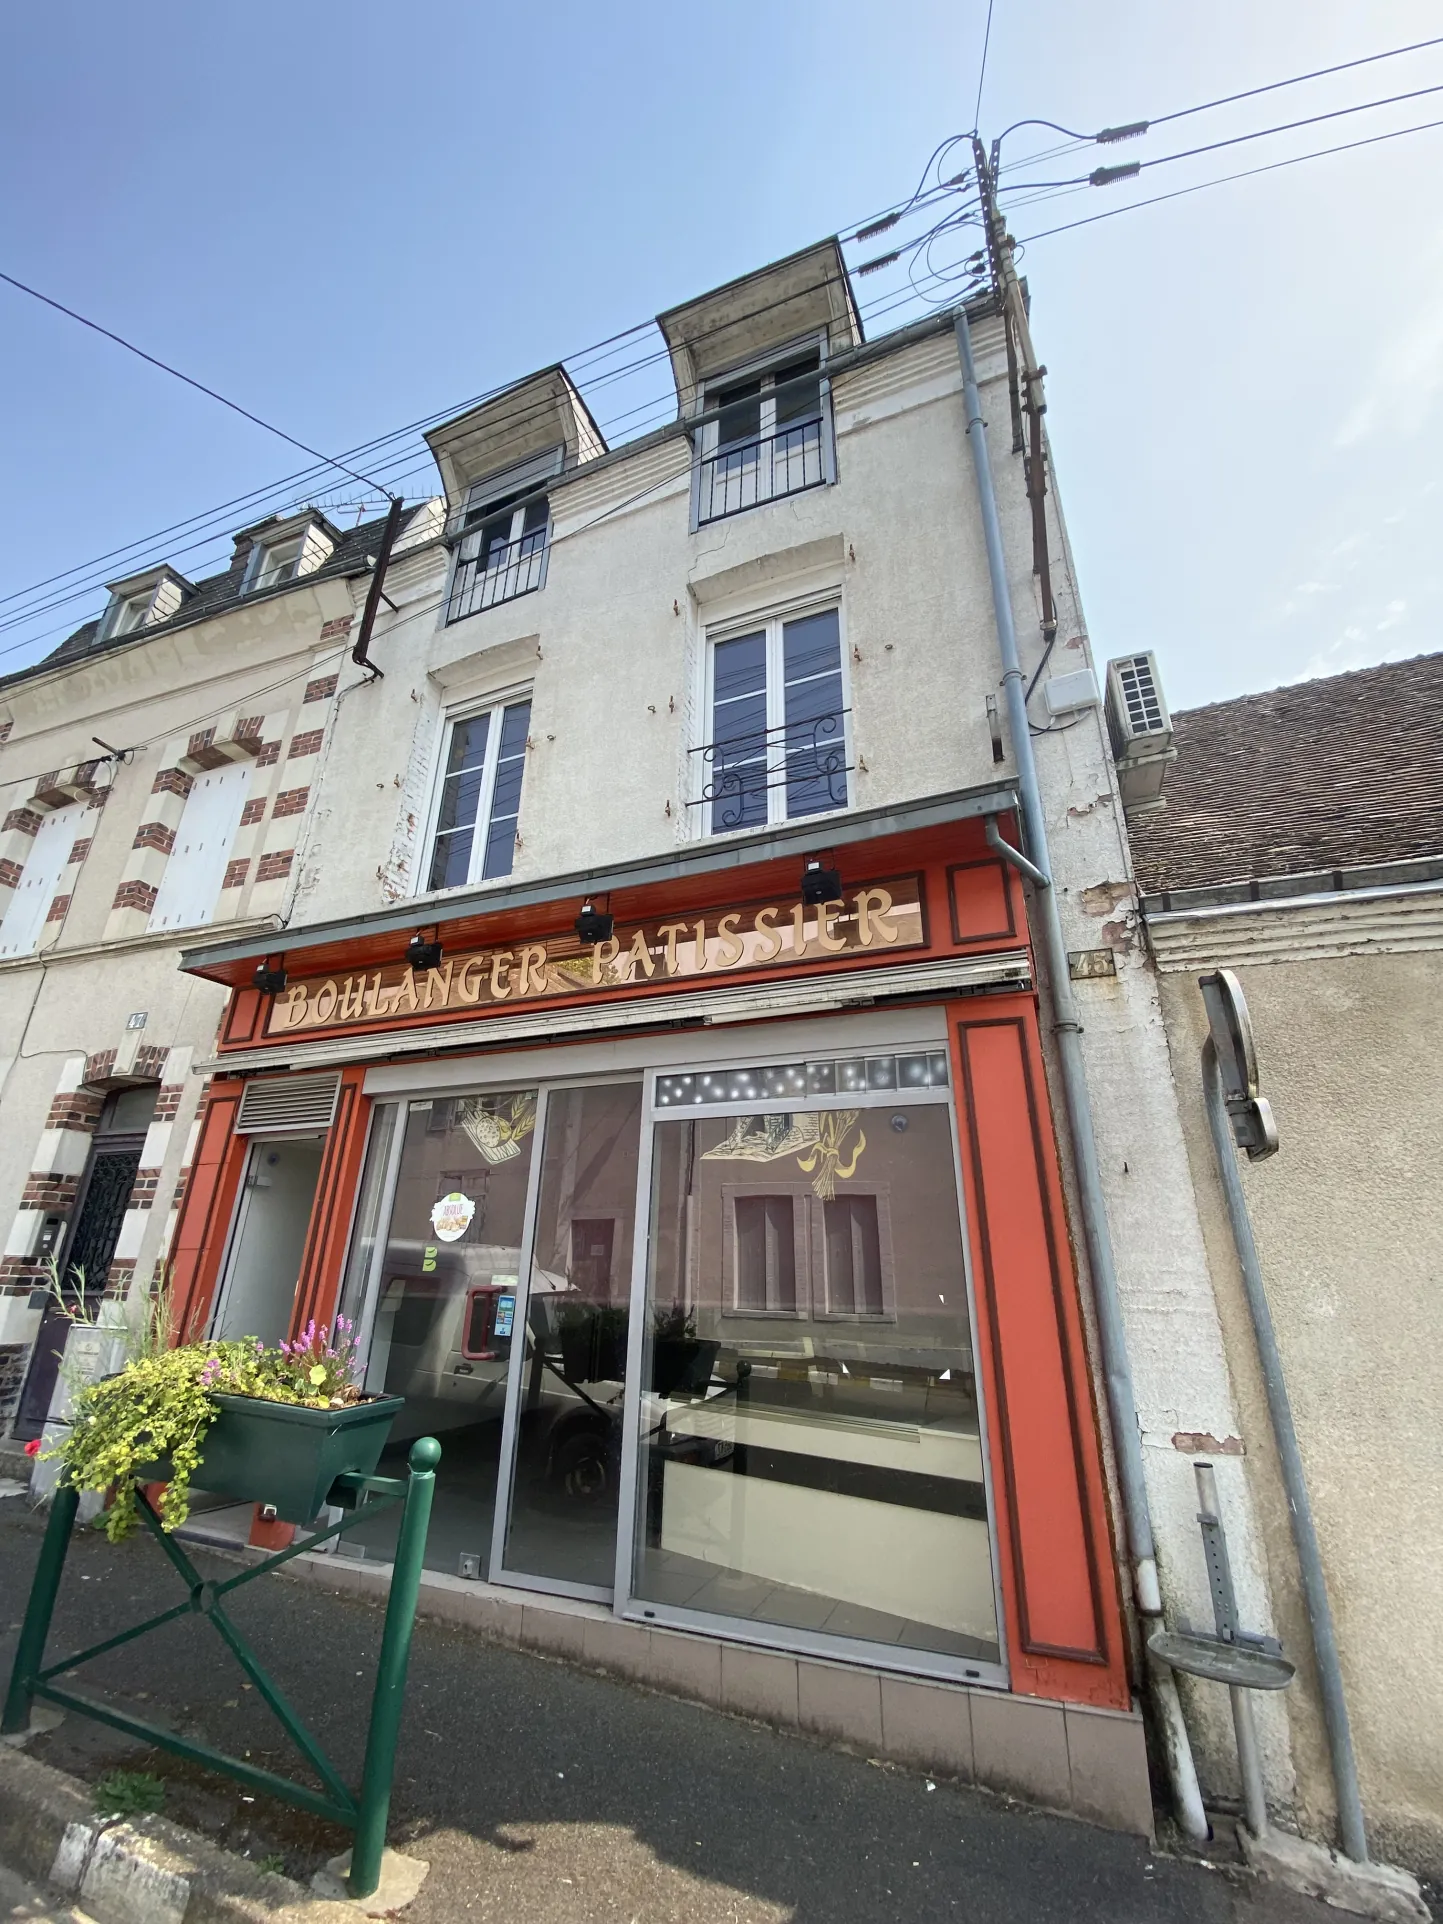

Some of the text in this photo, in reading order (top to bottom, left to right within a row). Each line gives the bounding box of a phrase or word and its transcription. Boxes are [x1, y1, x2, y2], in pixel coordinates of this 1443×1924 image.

[284, 888, 898, 1028] BOULANGER PATISSIER
[1076, 952, 1109, 976] 45
[128, 1013, 145, 1029] 47
